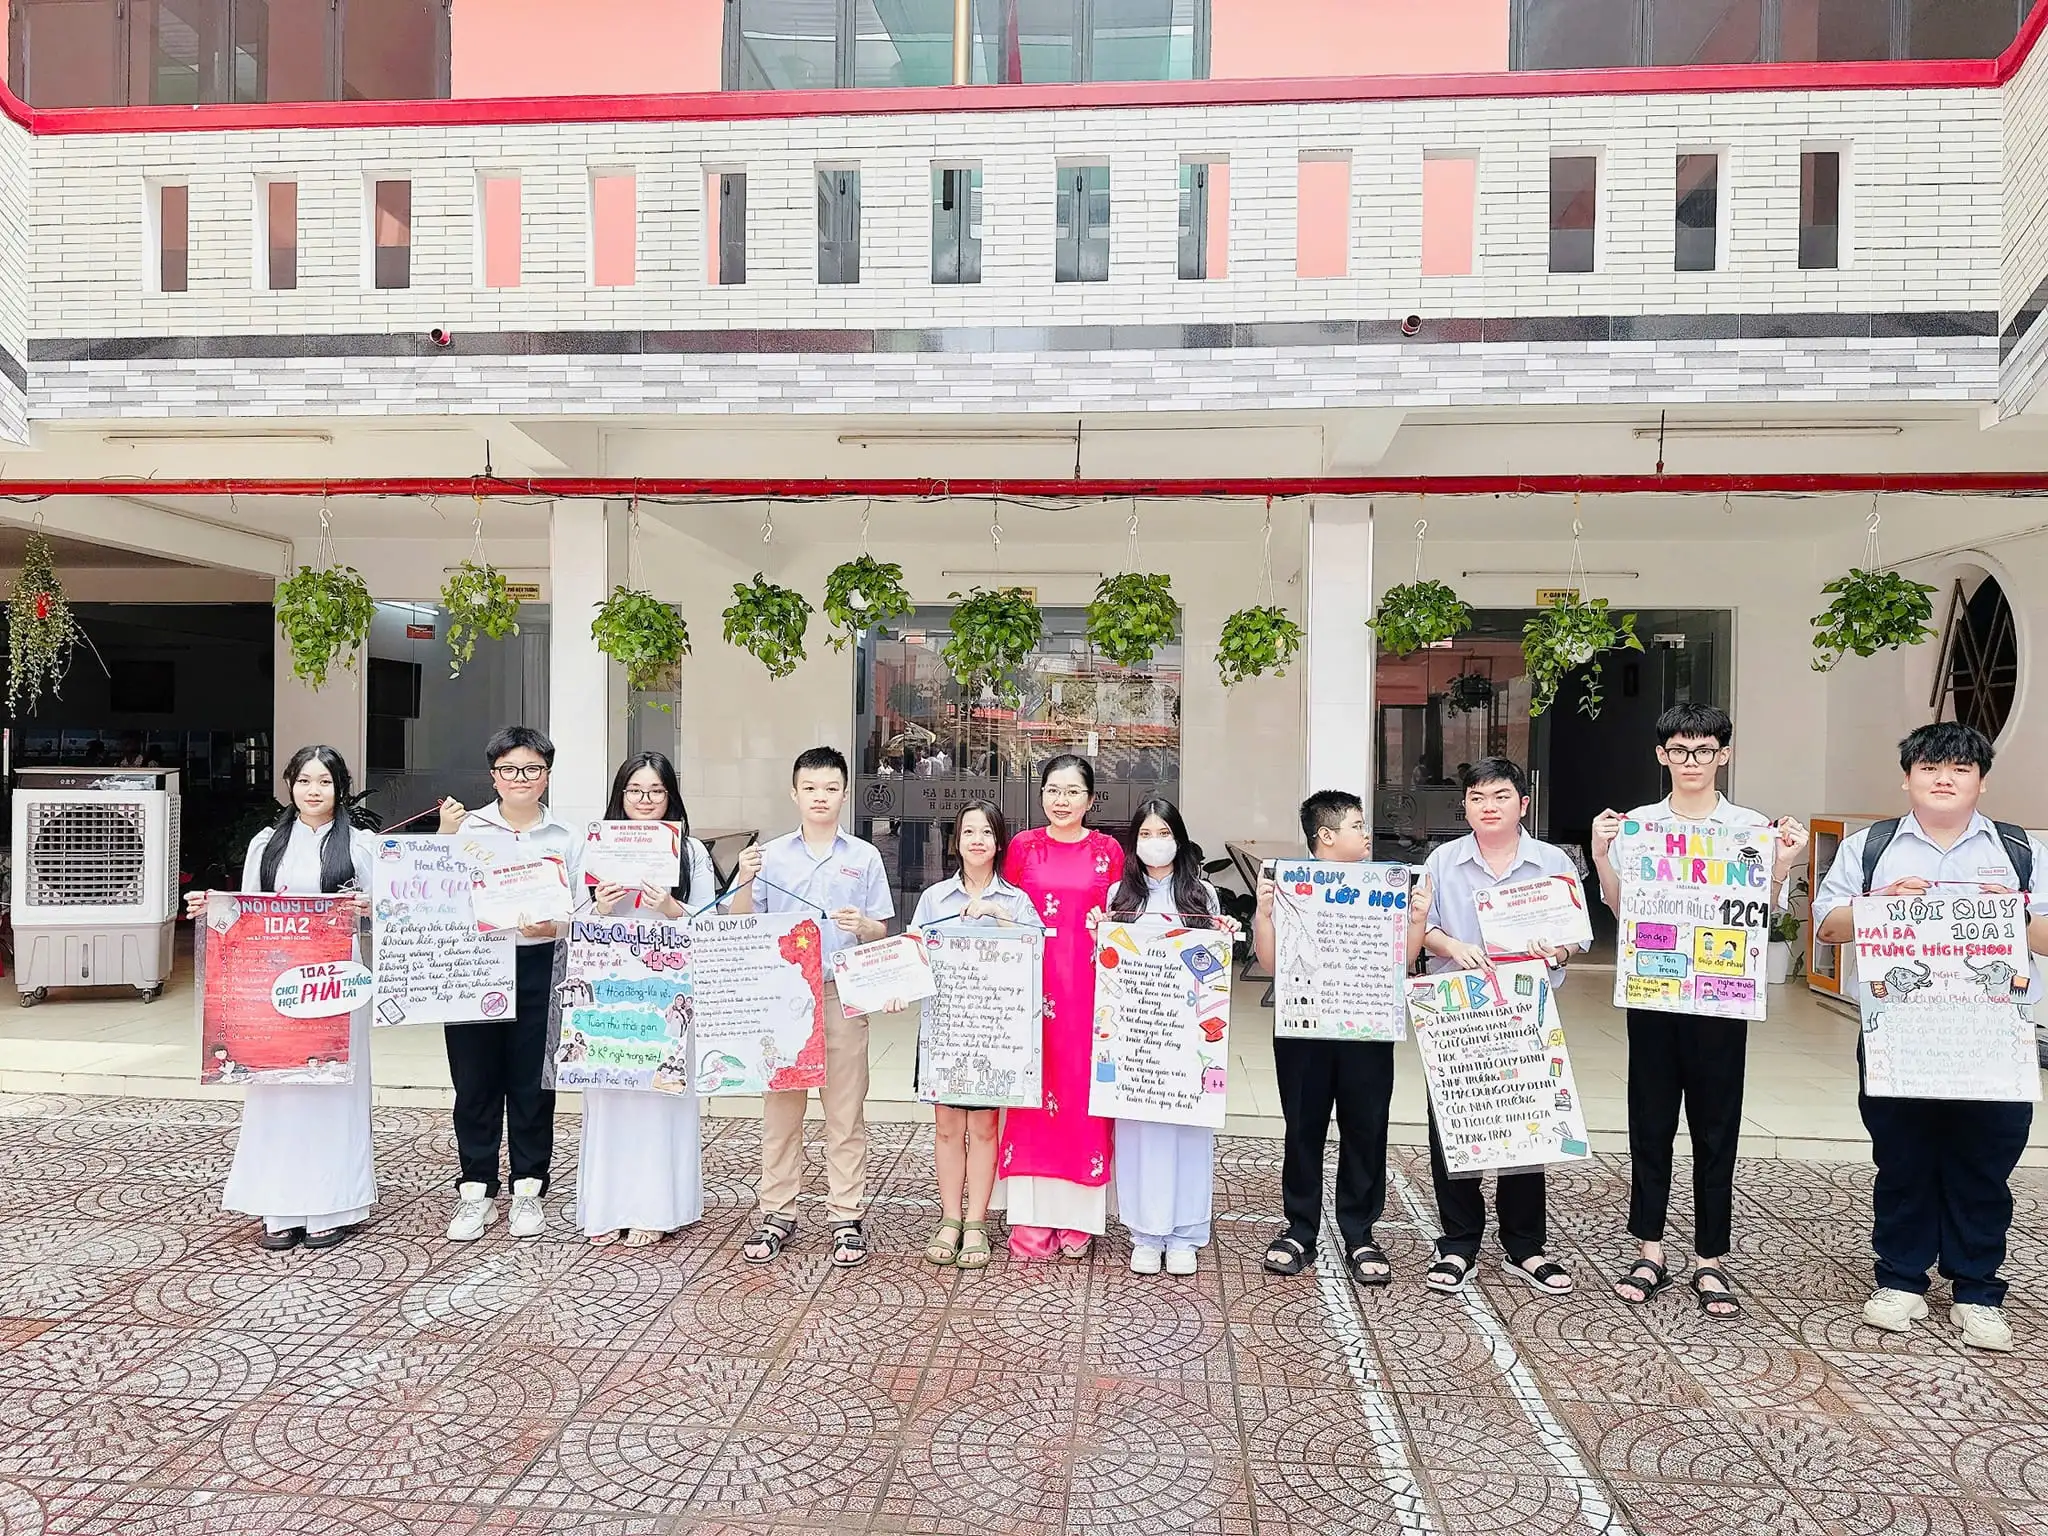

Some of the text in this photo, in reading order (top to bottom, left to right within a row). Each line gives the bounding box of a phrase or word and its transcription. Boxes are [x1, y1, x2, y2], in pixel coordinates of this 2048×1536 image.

[1665, 833, 1715, 858] HAI
[1313, 870, 1345, 884] QUY
[1368, 889, 1407, 912] HỌC
[1952, 898, 2018, 920] QUY
[1718, 898, 1769, 929] 12C1
[264, 917, 310, 934] 10A2
[1951, 922, 2015, 940] 10A1
[301, 976, 341, 1004] PHẢI
[1437, 971, 1508, 1012] 11B1
